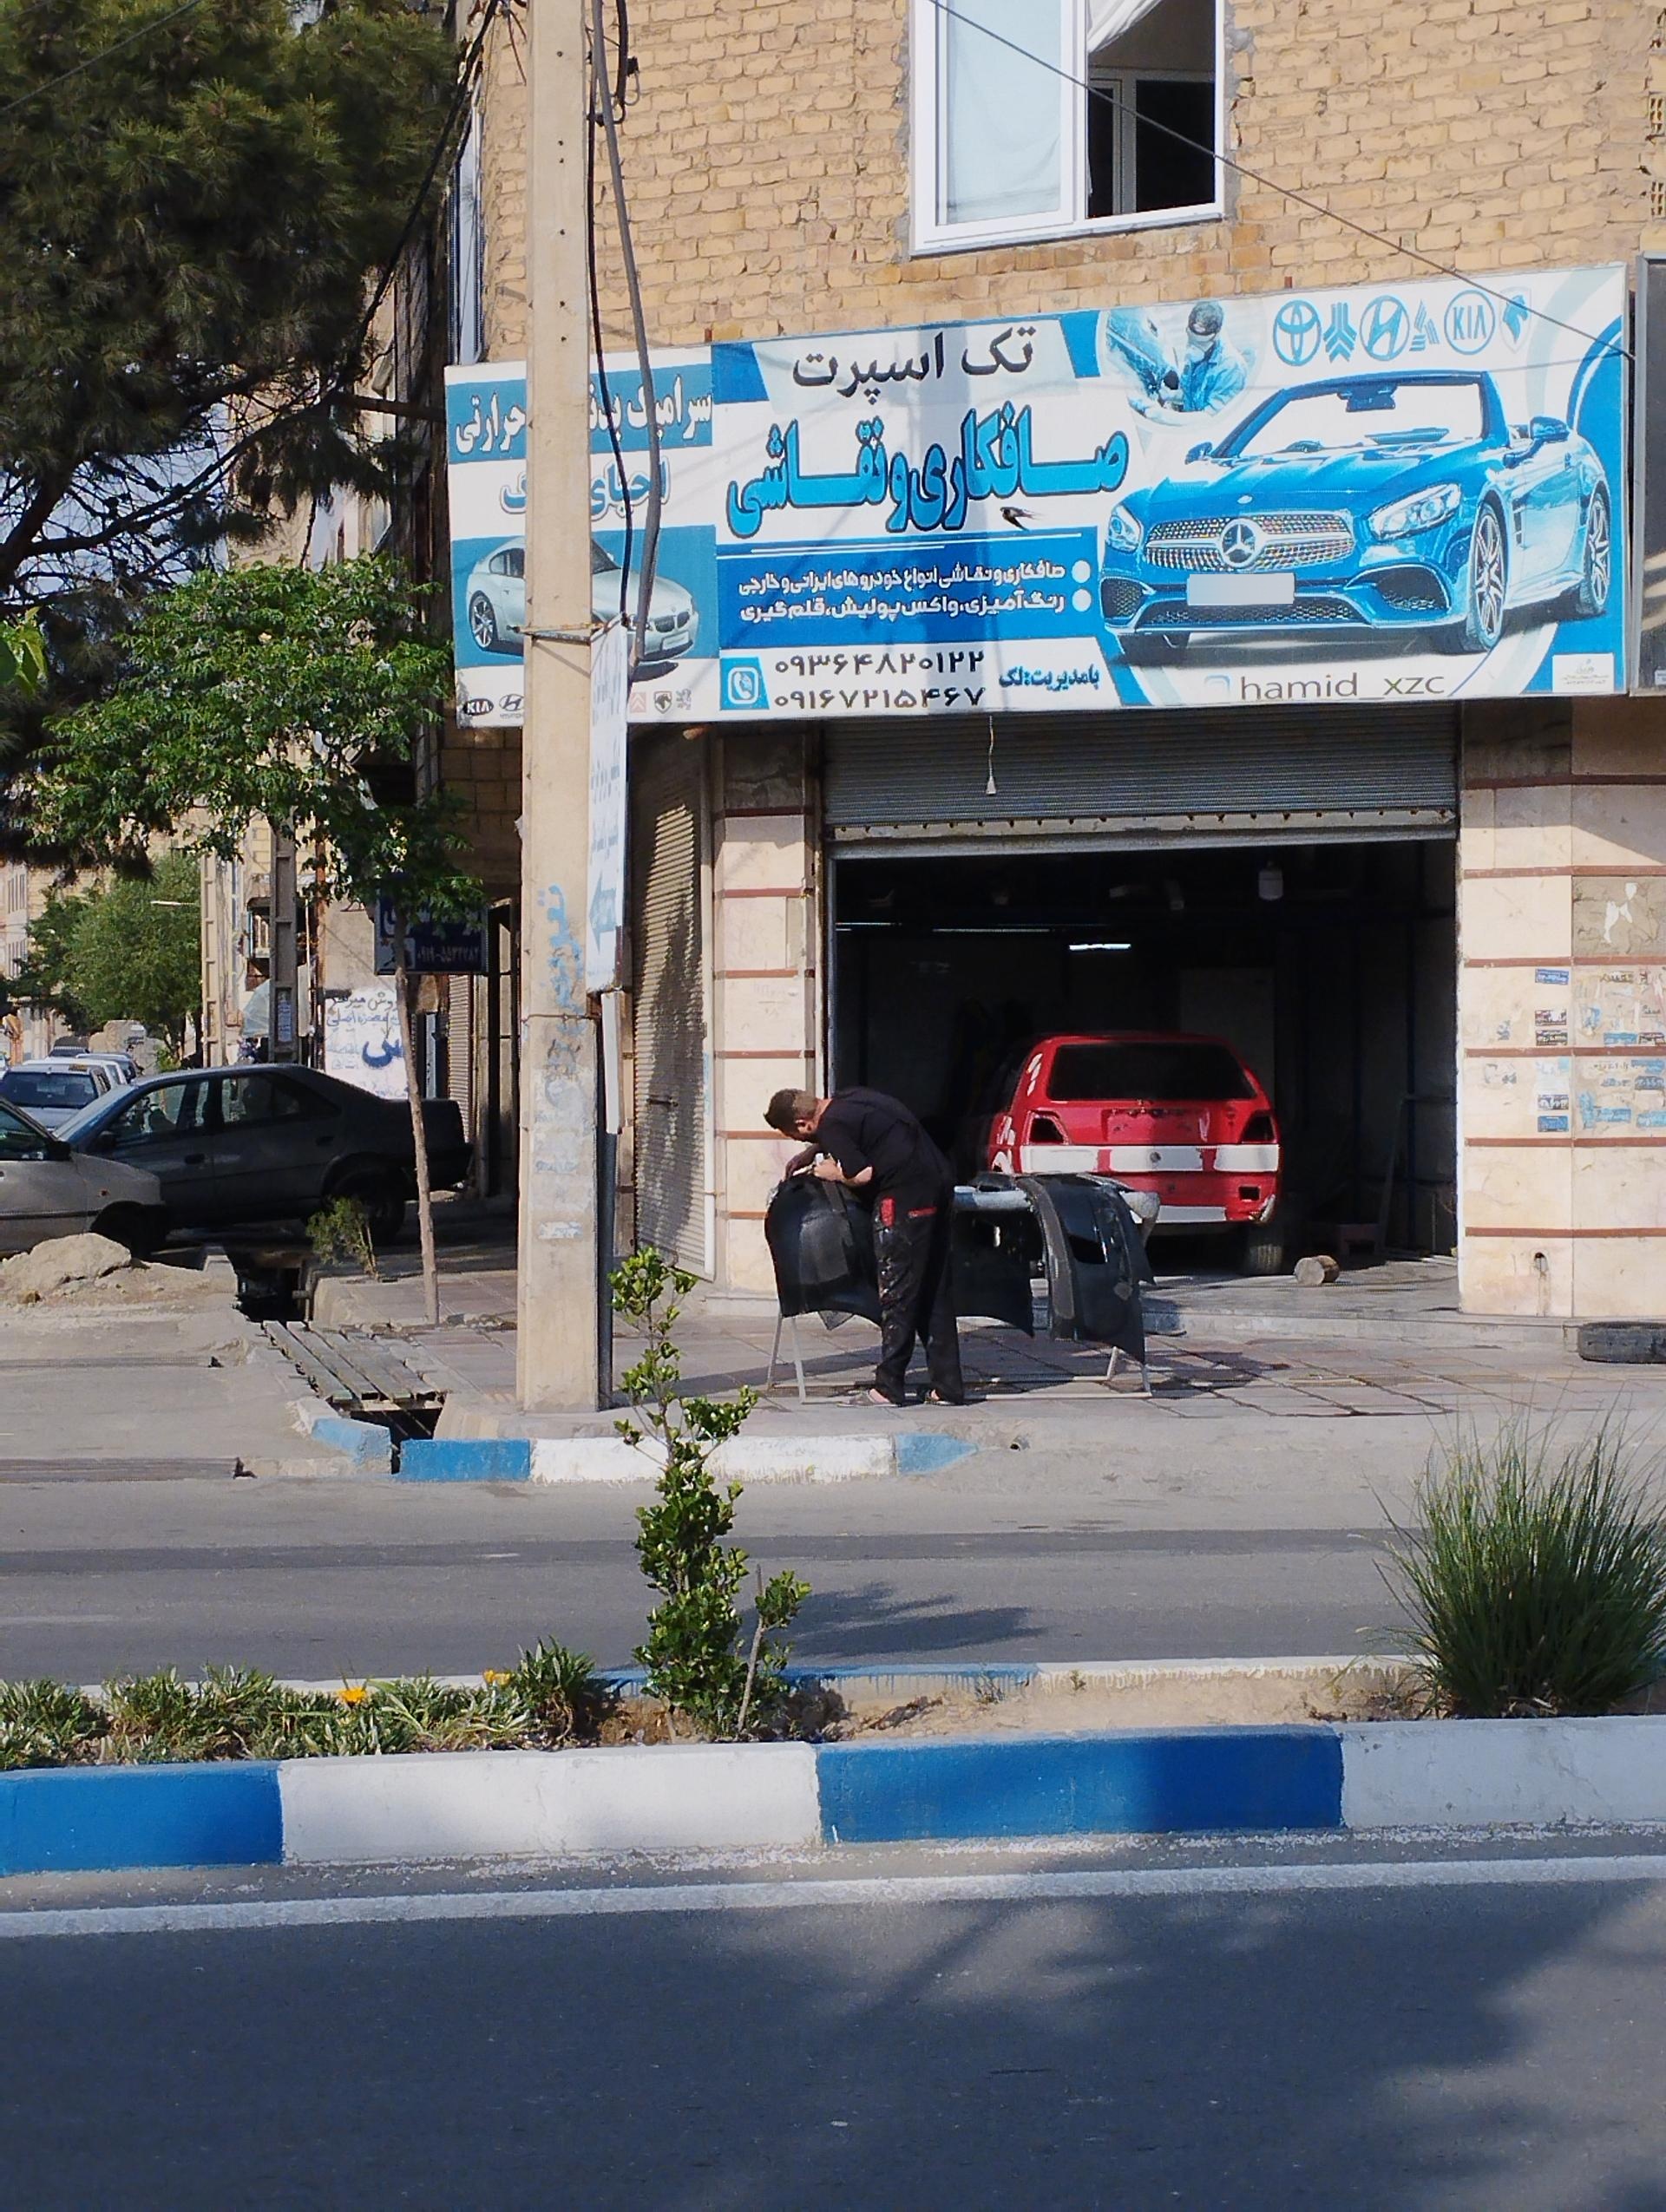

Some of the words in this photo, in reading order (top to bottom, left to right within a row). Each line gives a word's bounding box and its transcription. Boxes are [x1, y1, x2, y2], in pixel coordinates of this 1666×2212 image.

[1453, 304, 1487, 340] KIA
[792, 331, 944, 406] اسپرت
[961, 325, 1037, 376] تک
[726, 416, 888, 539] نقاشی
[909, 401, 1129, 532] صافکاری
[1003, 559, 1066, 586] صافکاری
[466, 700, 490, 714] KIA
